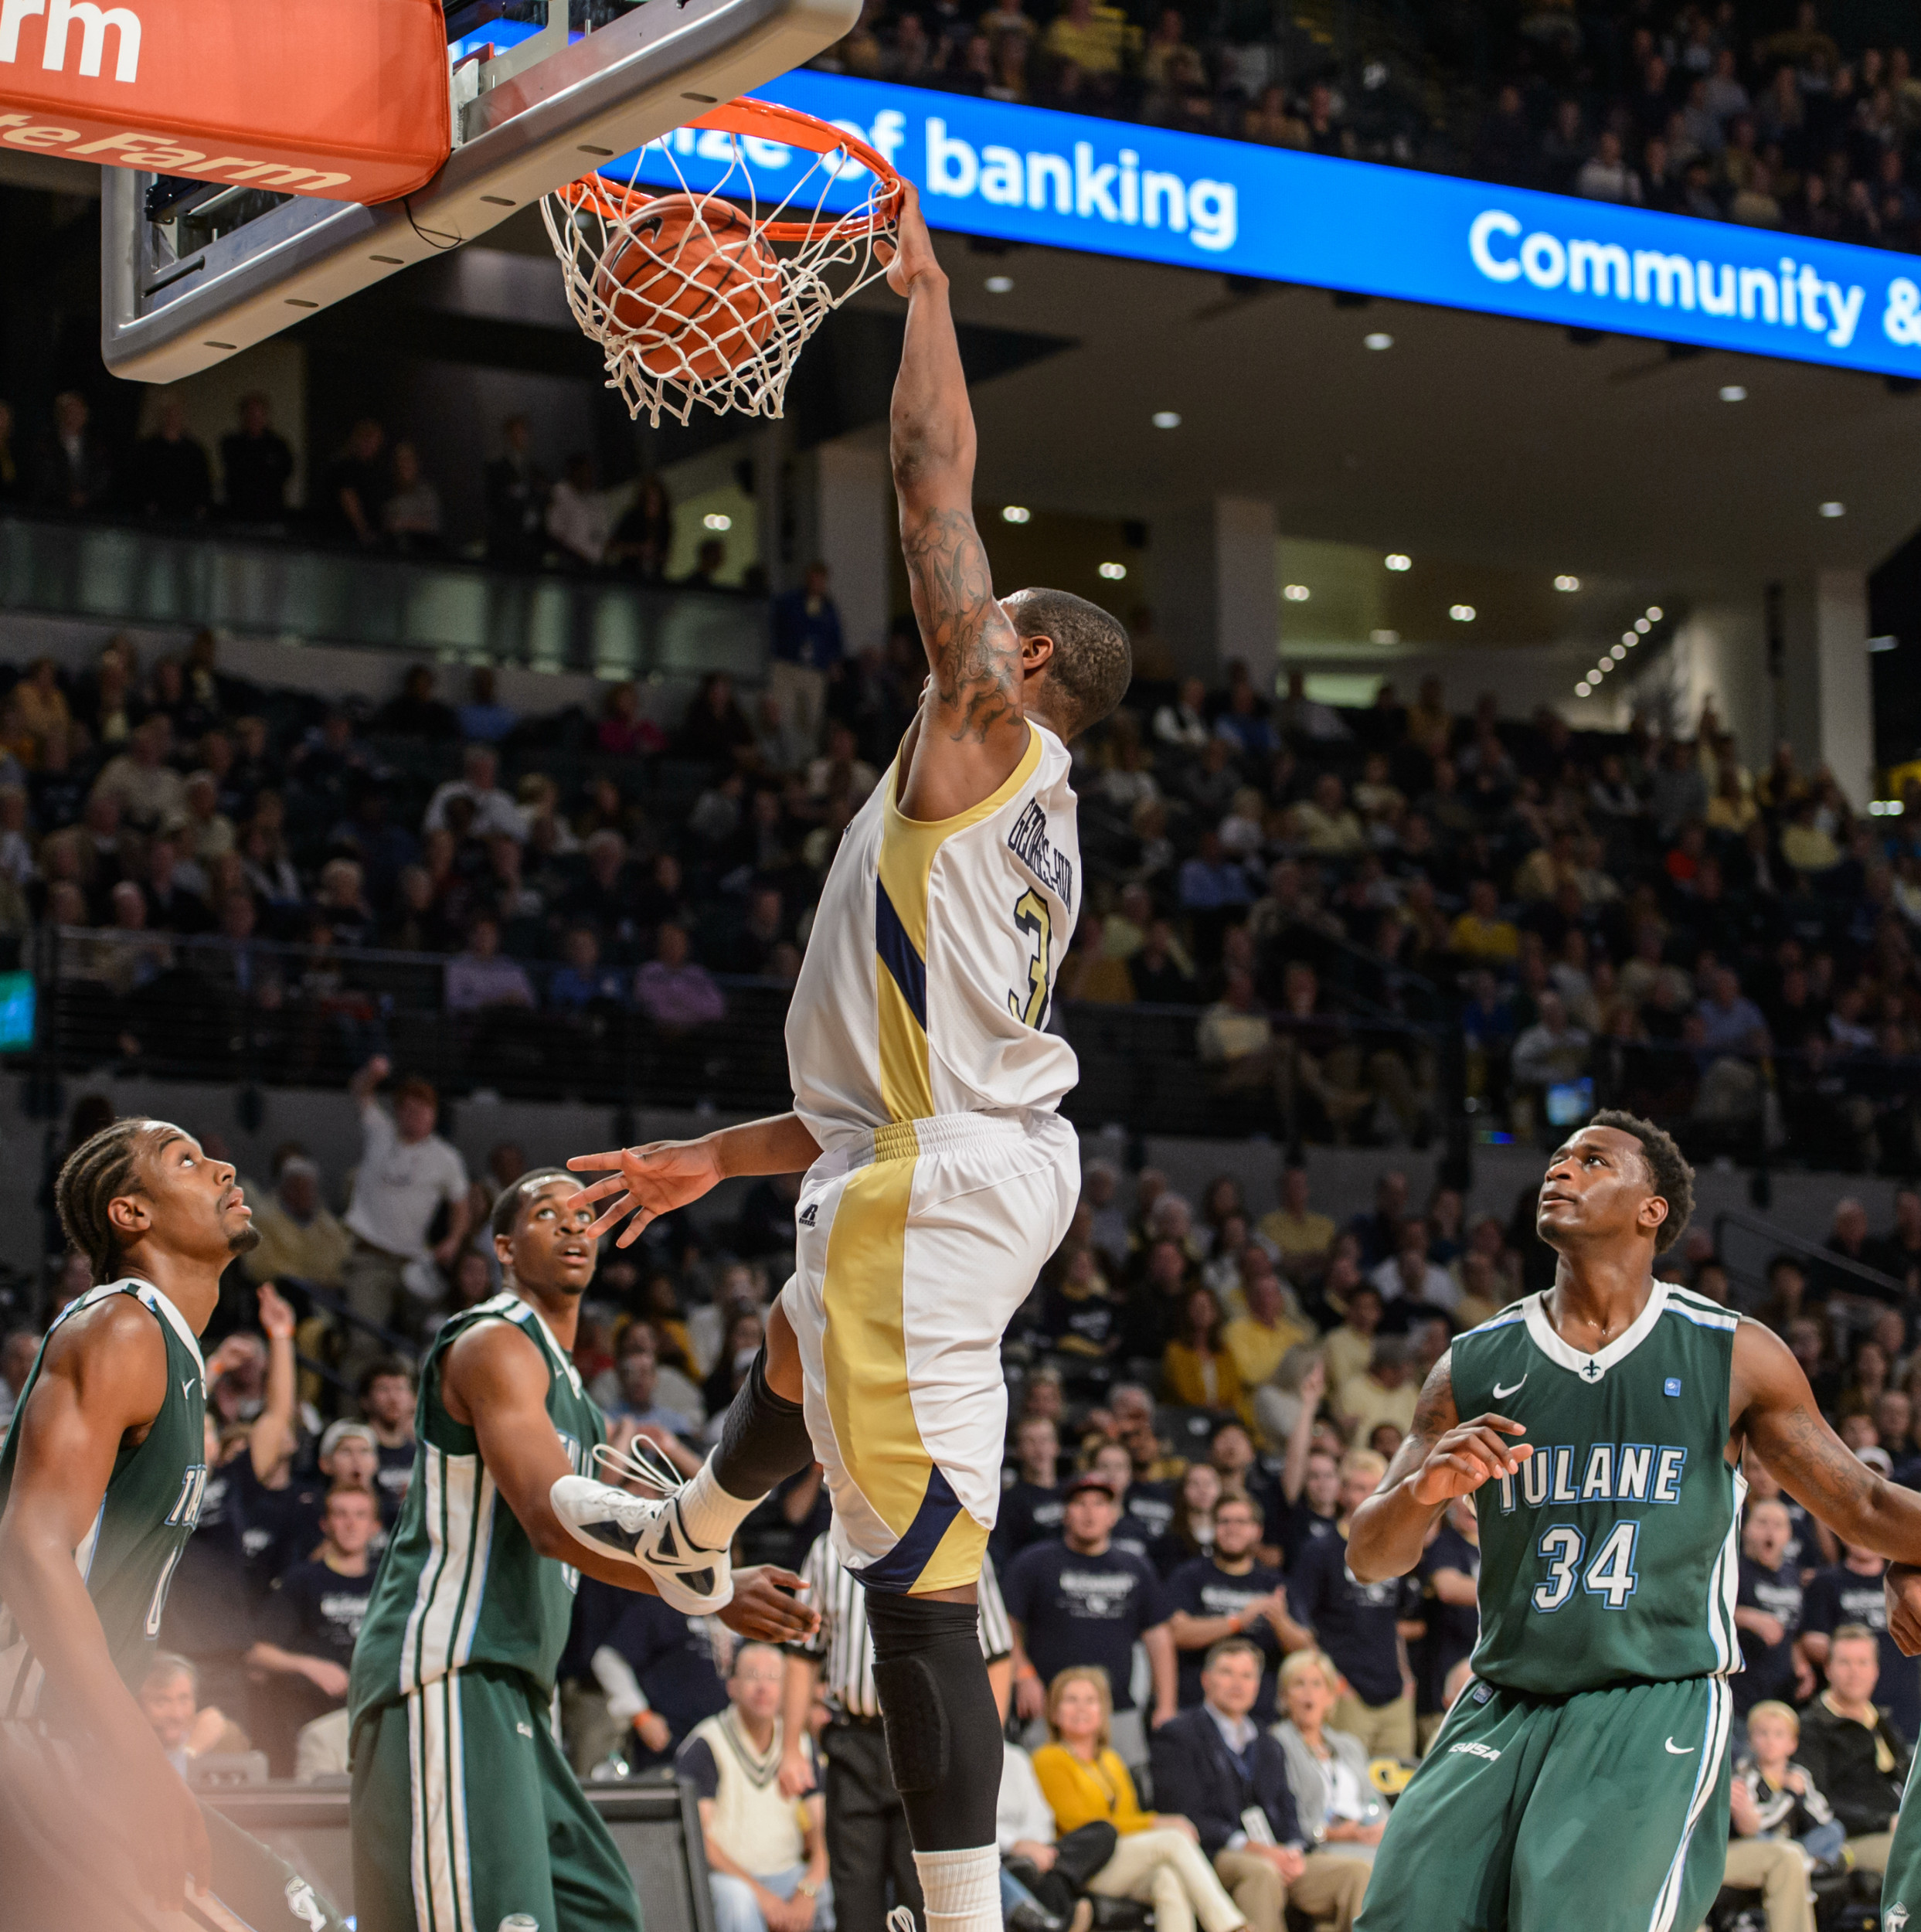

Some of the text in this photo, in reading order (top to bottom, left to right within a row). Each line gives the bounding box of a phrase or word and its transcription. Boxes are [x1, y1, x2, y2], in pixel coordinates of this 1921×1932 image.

[65, 132, 352, 190] Farm
[926, 117, 1237, 253] banking
[1469, 209, 1921, 348] Community &
[1008, 886, 1052, 1032] 3
[1532, 1519, 1640, 1614] 34
